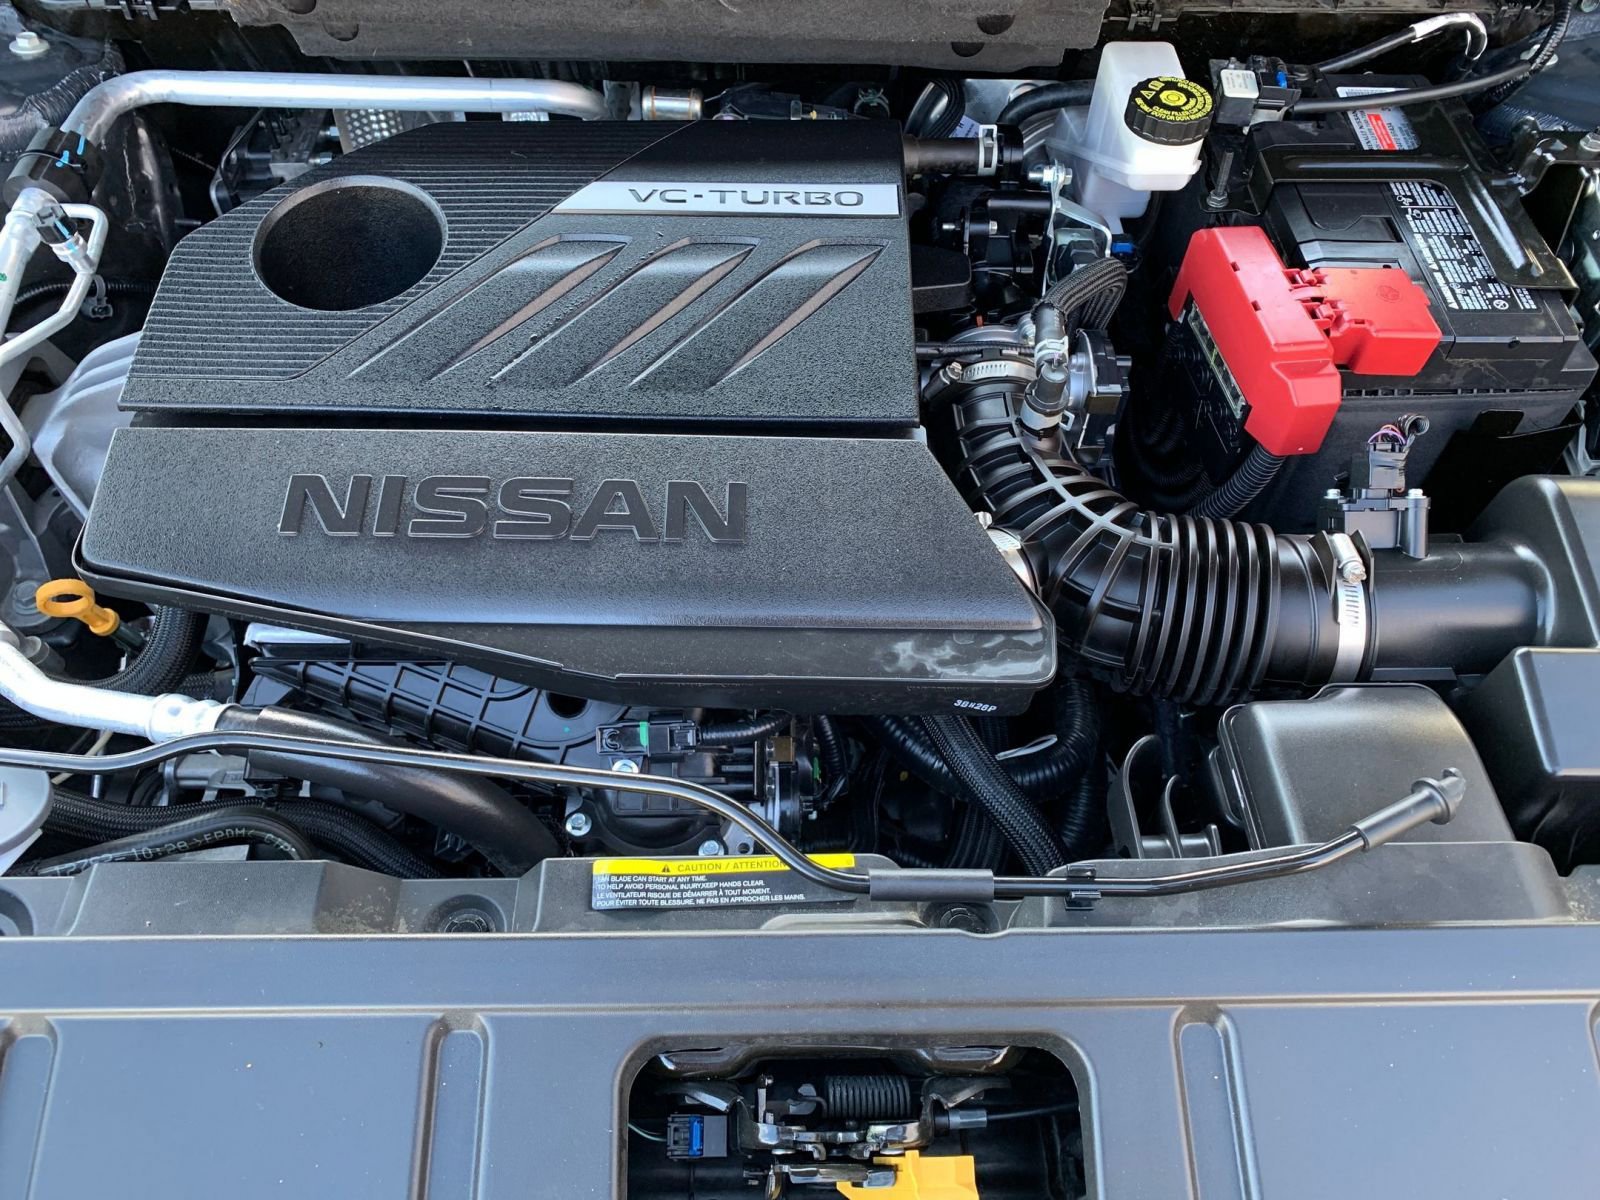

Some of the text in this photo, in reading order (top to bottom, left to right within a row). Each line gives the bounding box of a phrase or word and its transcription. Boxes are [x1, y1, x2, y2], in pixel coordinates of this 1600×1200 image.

[629, 189, 864, 206] VC-TURBO
[278, 474, 746, 544] NISSAN
[677, 863, 722, 872] CAUTION
[719, 880, 742, 888] HANDS
[742, 879, 766, 887] CLEAR.
[605, 891, 647, 899] VENTILATEUR
[682, 889, 718, 898] DÉMARRER
[742, 887, 771, 895] MOMENT.
[615, 898, 637, 906] ÉVITER
[730, 895, 771, 903] APPROCHER
